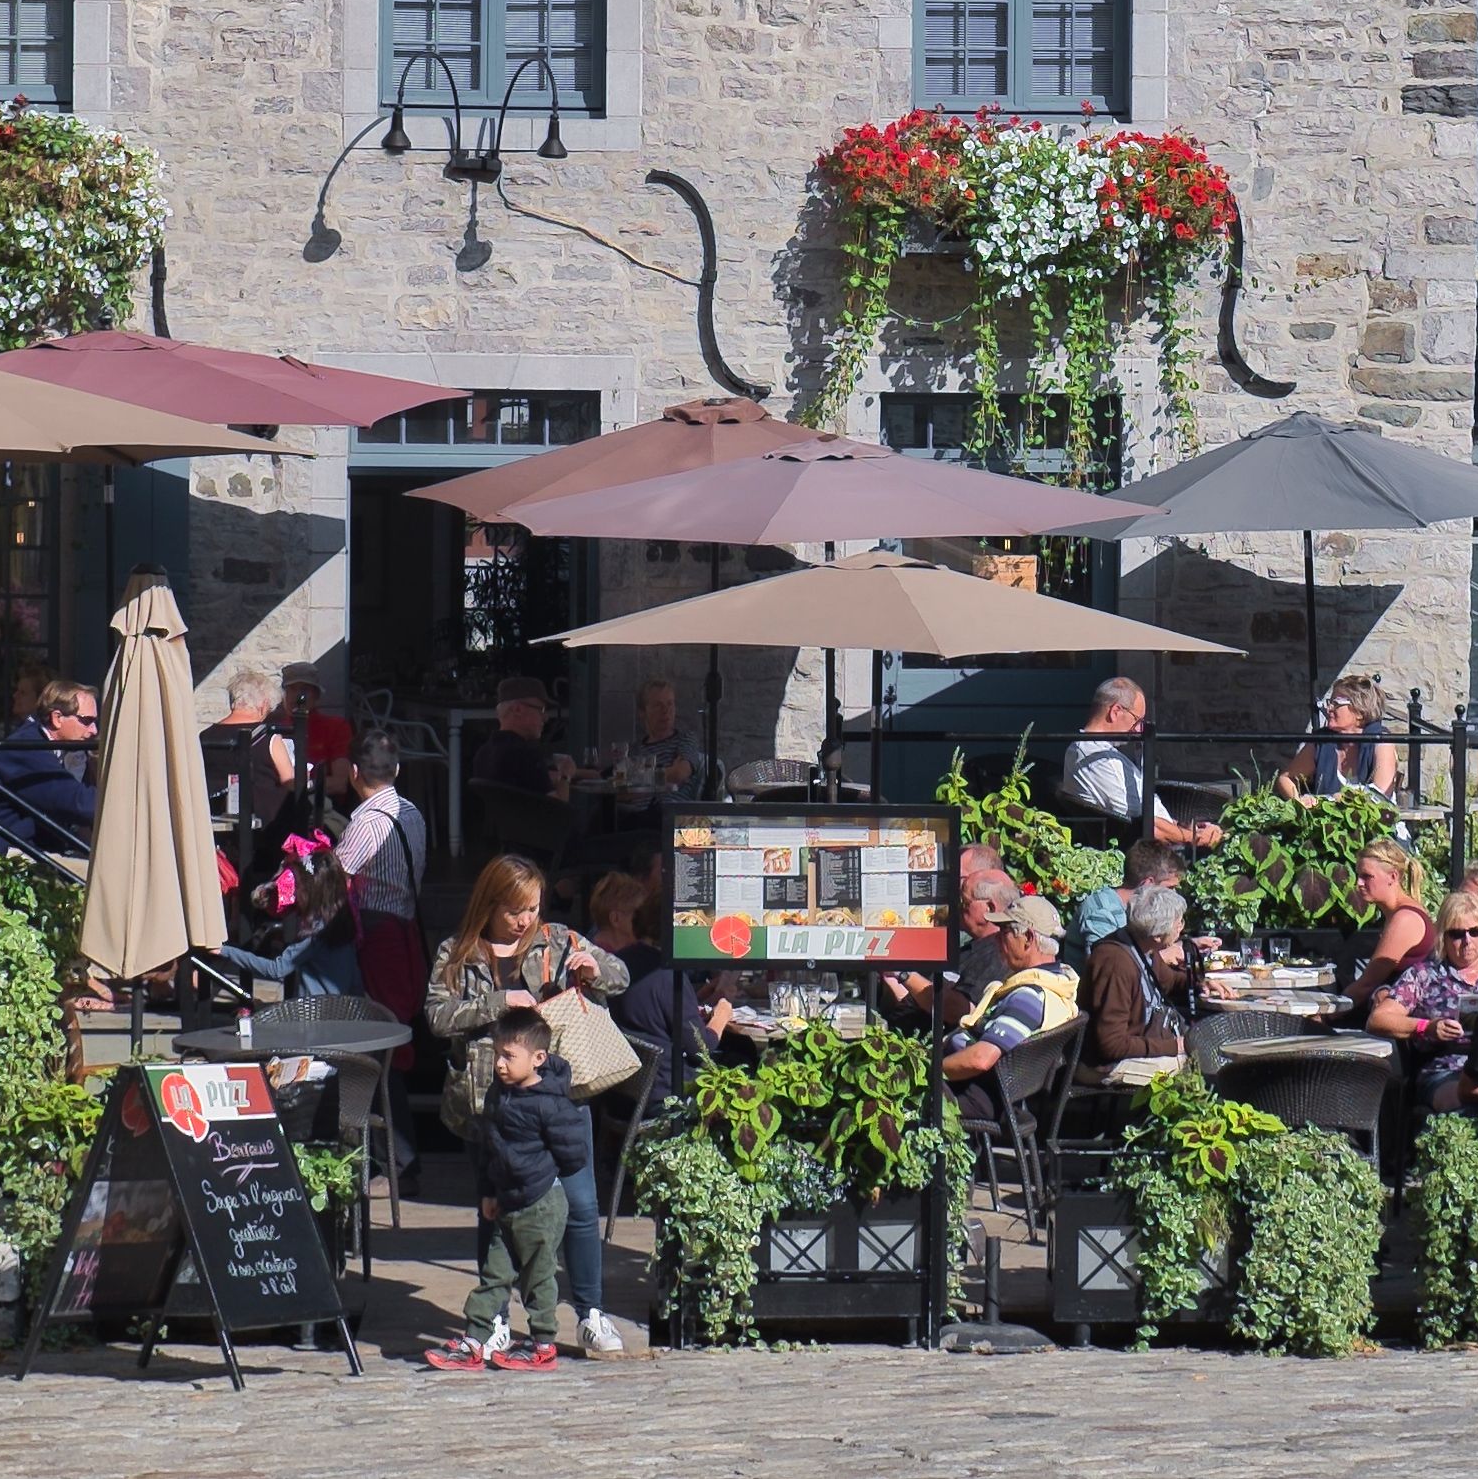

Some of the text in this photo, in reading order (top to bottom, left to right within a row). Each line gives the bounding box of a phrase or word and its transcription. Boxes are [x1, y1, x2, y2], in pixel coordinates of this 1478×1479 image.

[778, 930, 895, 956] LA PIZZ
[170, 1080, 250, 1108] LA PIZZ
